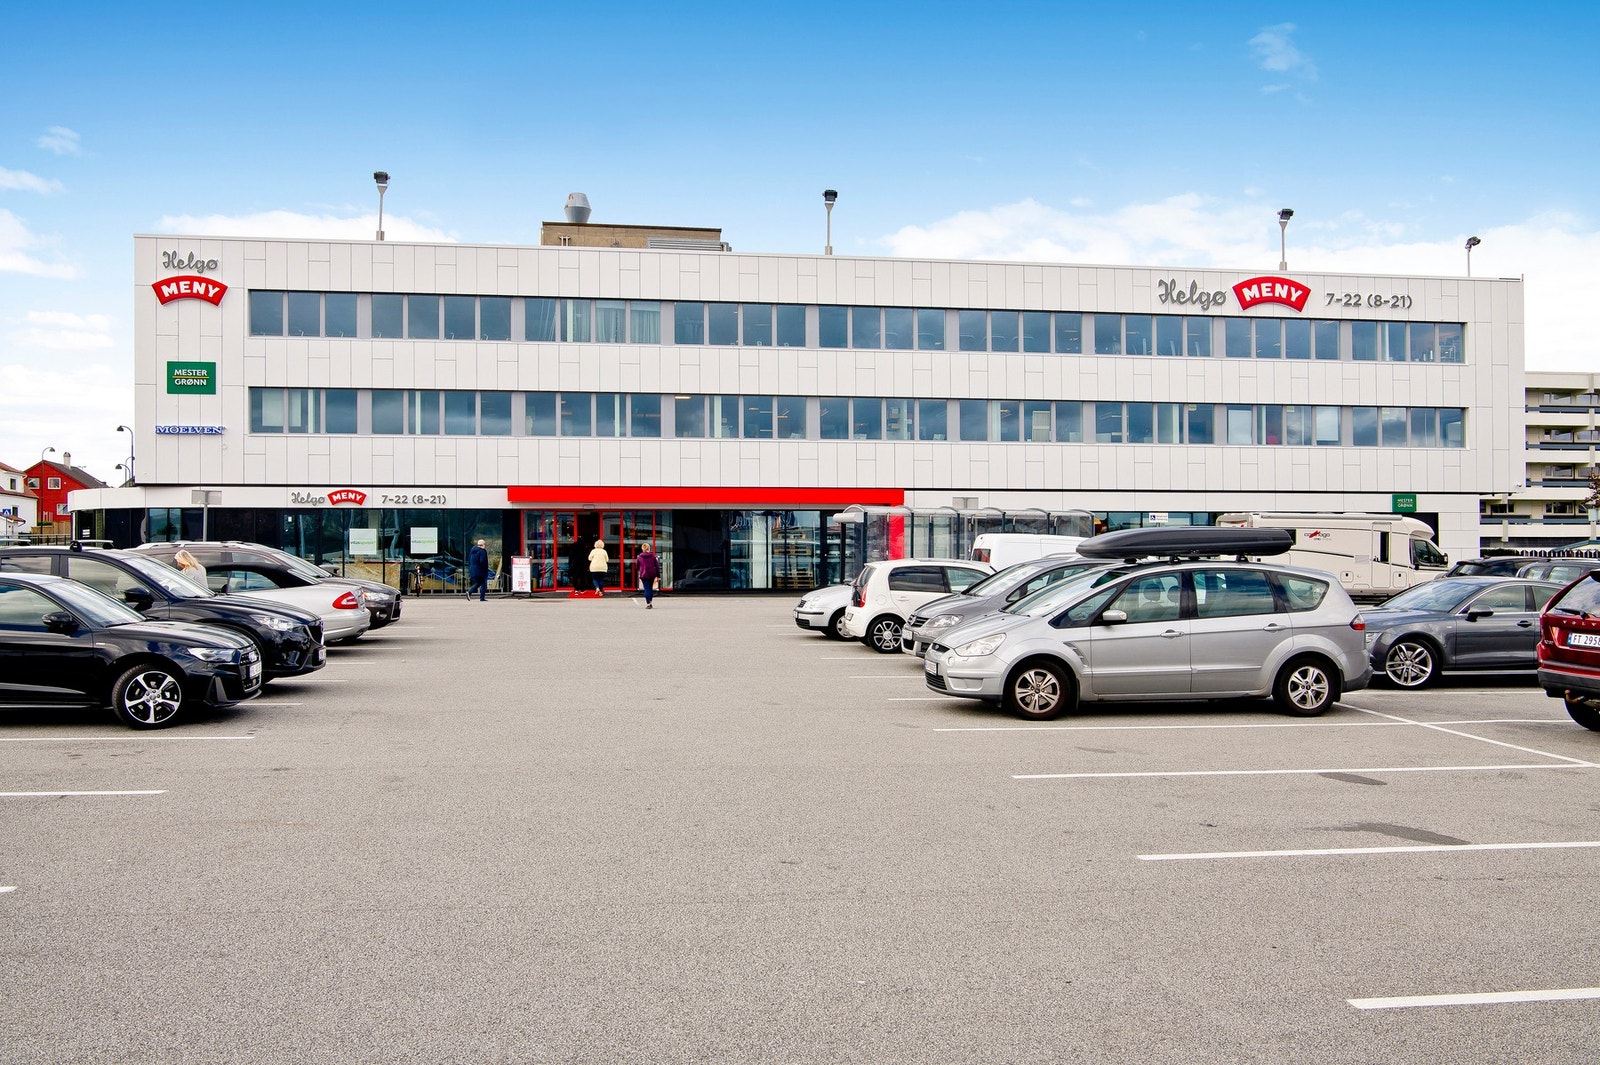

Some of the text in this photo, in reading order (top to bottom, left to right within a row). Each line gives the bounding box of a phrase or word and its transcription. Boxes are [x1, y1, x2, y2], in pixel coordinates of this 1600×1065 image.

[162, 250, 218, 273] Helgø
[160, 280, 221, 299] MENY
[1158, 279, 1413, 310] Helgø MENY 7-22 (8-21)
[174, 369, 208, 377] MESTER
[174, 378, 207, 386] GRØNN
[155, 425, 225, 435] MOELVEN
[291, 492, 447, 506] Helgø MENY 7-22 (8-21)
[1573, 635, 1583, 643] FT
